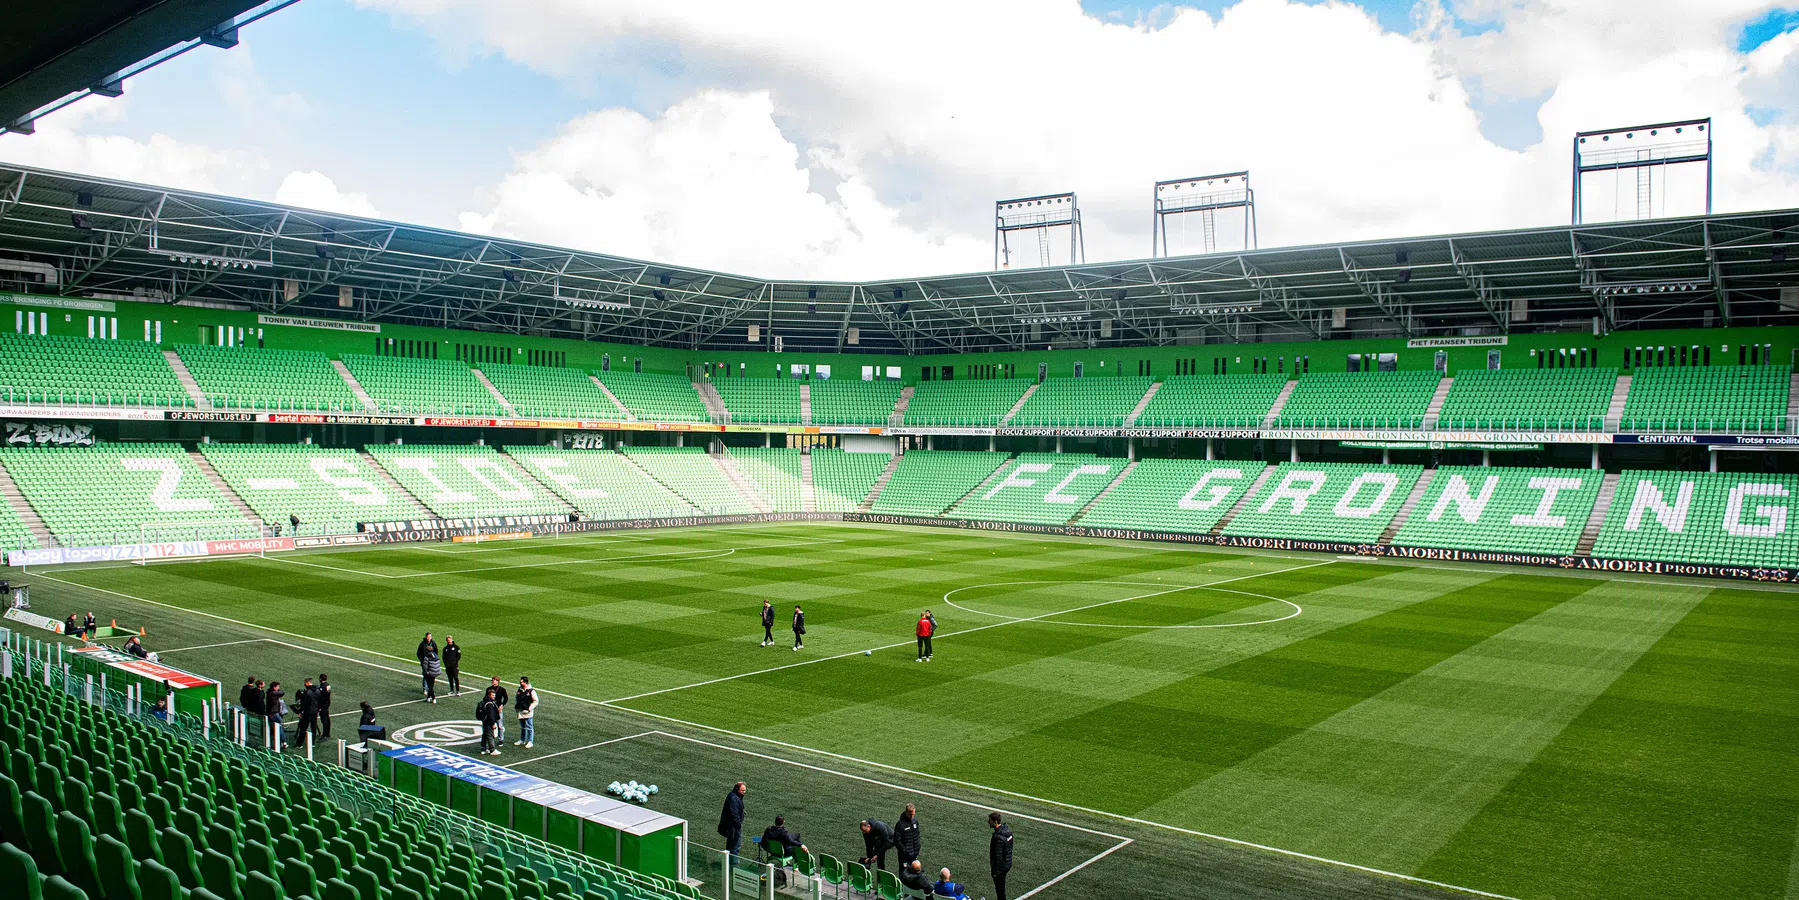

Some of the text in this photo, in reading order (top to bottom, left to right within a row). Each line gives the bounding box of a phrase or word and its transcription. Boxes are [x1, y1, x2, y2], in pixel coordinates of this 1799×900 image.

[64, 300, 103, 309] GRONINGEN
[264, 316, 375, 331] TONNY VAN LEEUWEN TRIBUNE
[1430, 338, 1466, 346] FRANSEN
[1468, 337, 1503, 345] TRIBUNE
[171, 412, 251, 421] OFJEWORSTLUST.EU
[275, 414, 299, 422] bestel
[300, 415, 324, 423] online
[337, 416, 369, 424] lekkerste
[370, 417, 390, 425] droge
[430, 418, 490, 426] OFJEWORSTLUST.EU
[1151, 430, 1185, 438] SUPPORT
[1638, 435, 1696, 443] CENTURY.NL
[1736, 436, 1764, 444] Trotse
[982, 463, 1110, 504] FC
[653, 515, 748, 528] AMOERI BARBERSHOPS
[757, 512, 842, 522] AMOERI PRODUCTS
[861, 514, 957, 526] AMOERI BARBERSHOPS
[364, 521, 406, 533] STOP
[534, 521, 586, 534] AMOERI
[588, 521, 633, 530] PRODUCTS
[968, 521, 1064, 534] AMOERI PRODUCTS
[385, 528, 448, 542] AMOERI
[450, 528, 521, 537] BARBERSHOPS
[1087, 528, 1214, 543] AMOERI BARBERSHOPS
[214, 539, 283, 551] MHC MOBLITY
[1228, 537, 1356, 552] AMOERI PRODUCTS
[12, 549, 61, 562] topay
[64, 547, 111, 560] topay
[1387, 546, 1557, 565] AMOERI BARBERSHOPS
[1577, 557, 1749, 577] AMOERI PRODUCTS
